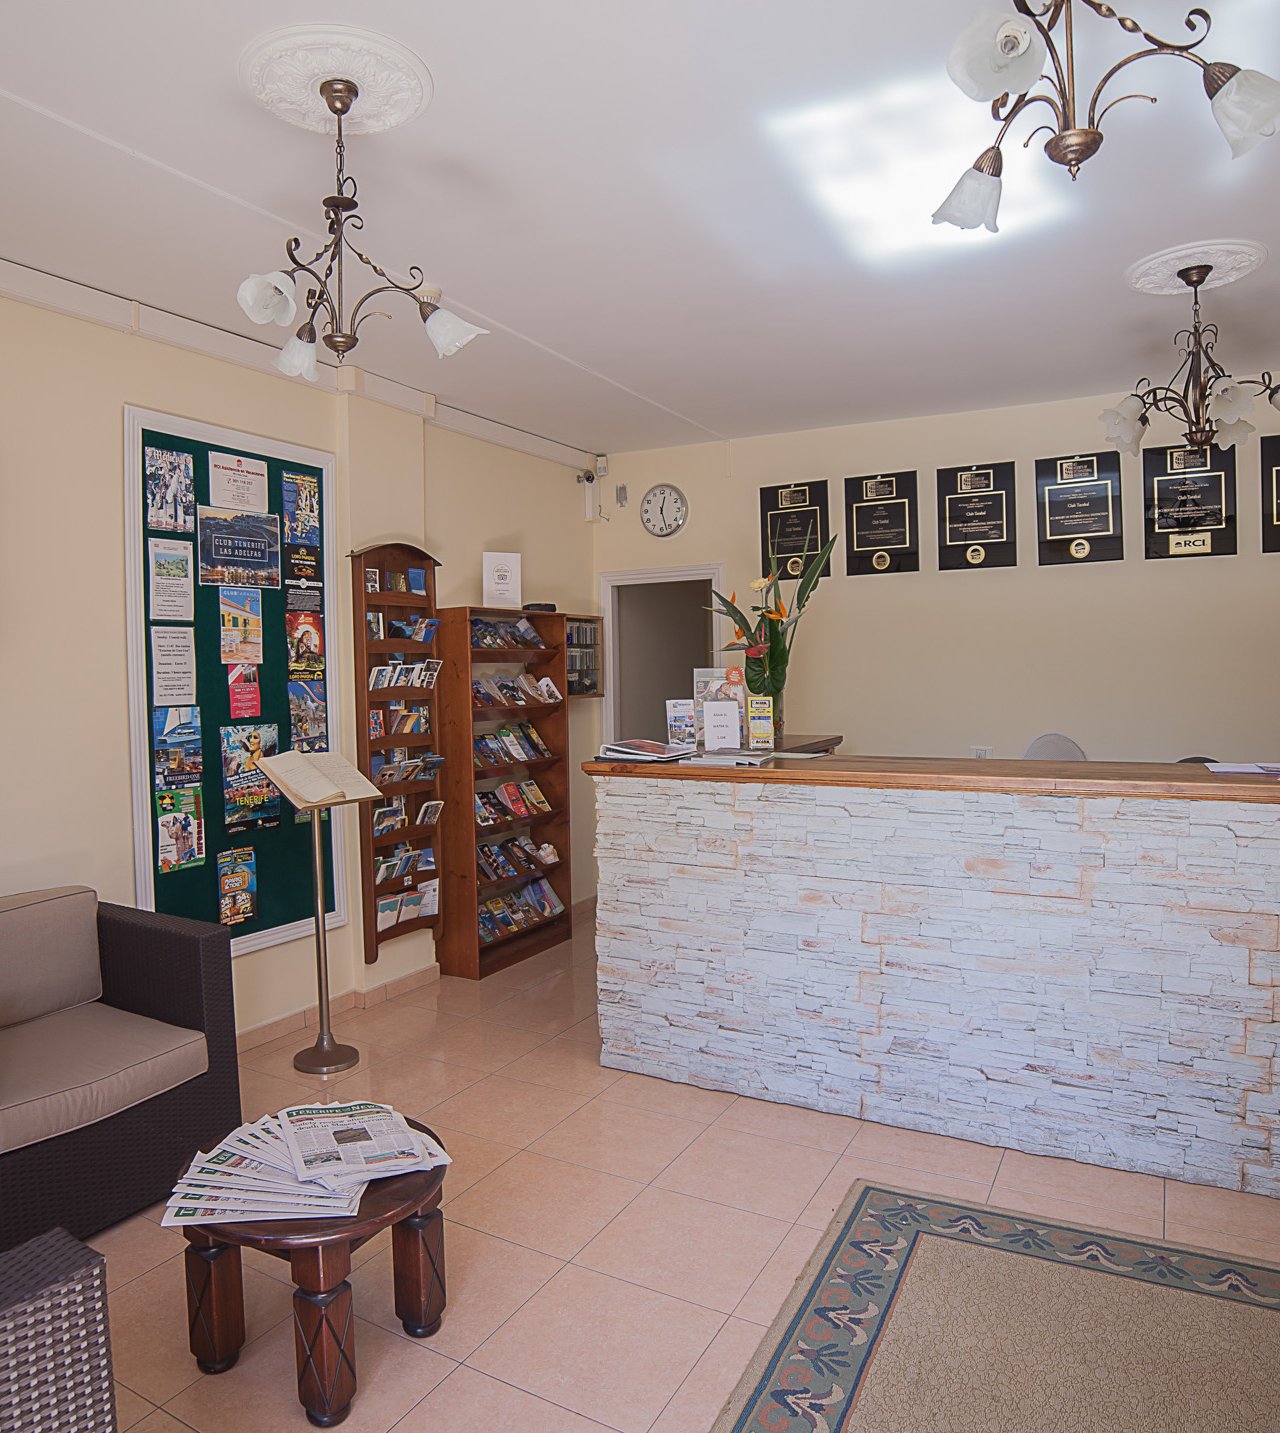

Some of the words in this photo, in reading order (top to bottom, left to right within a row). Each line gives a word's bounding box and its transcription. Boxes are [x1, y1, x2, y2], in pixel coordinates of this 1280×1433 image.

[214, 538, 232, 546] CLUB
[234, 540, 265, 550] TENERIFE
[1184, 539, 1206, 548] RCI
[234, 549, 262, 558] ADELFAS
[166, 774, 190, 782] FREEBIRD
[235, 794, 269, 806] TENERIFE
[289, 1108, 342, 1116] TENERIFE
[293, 1120, 317, 1128] Safety
